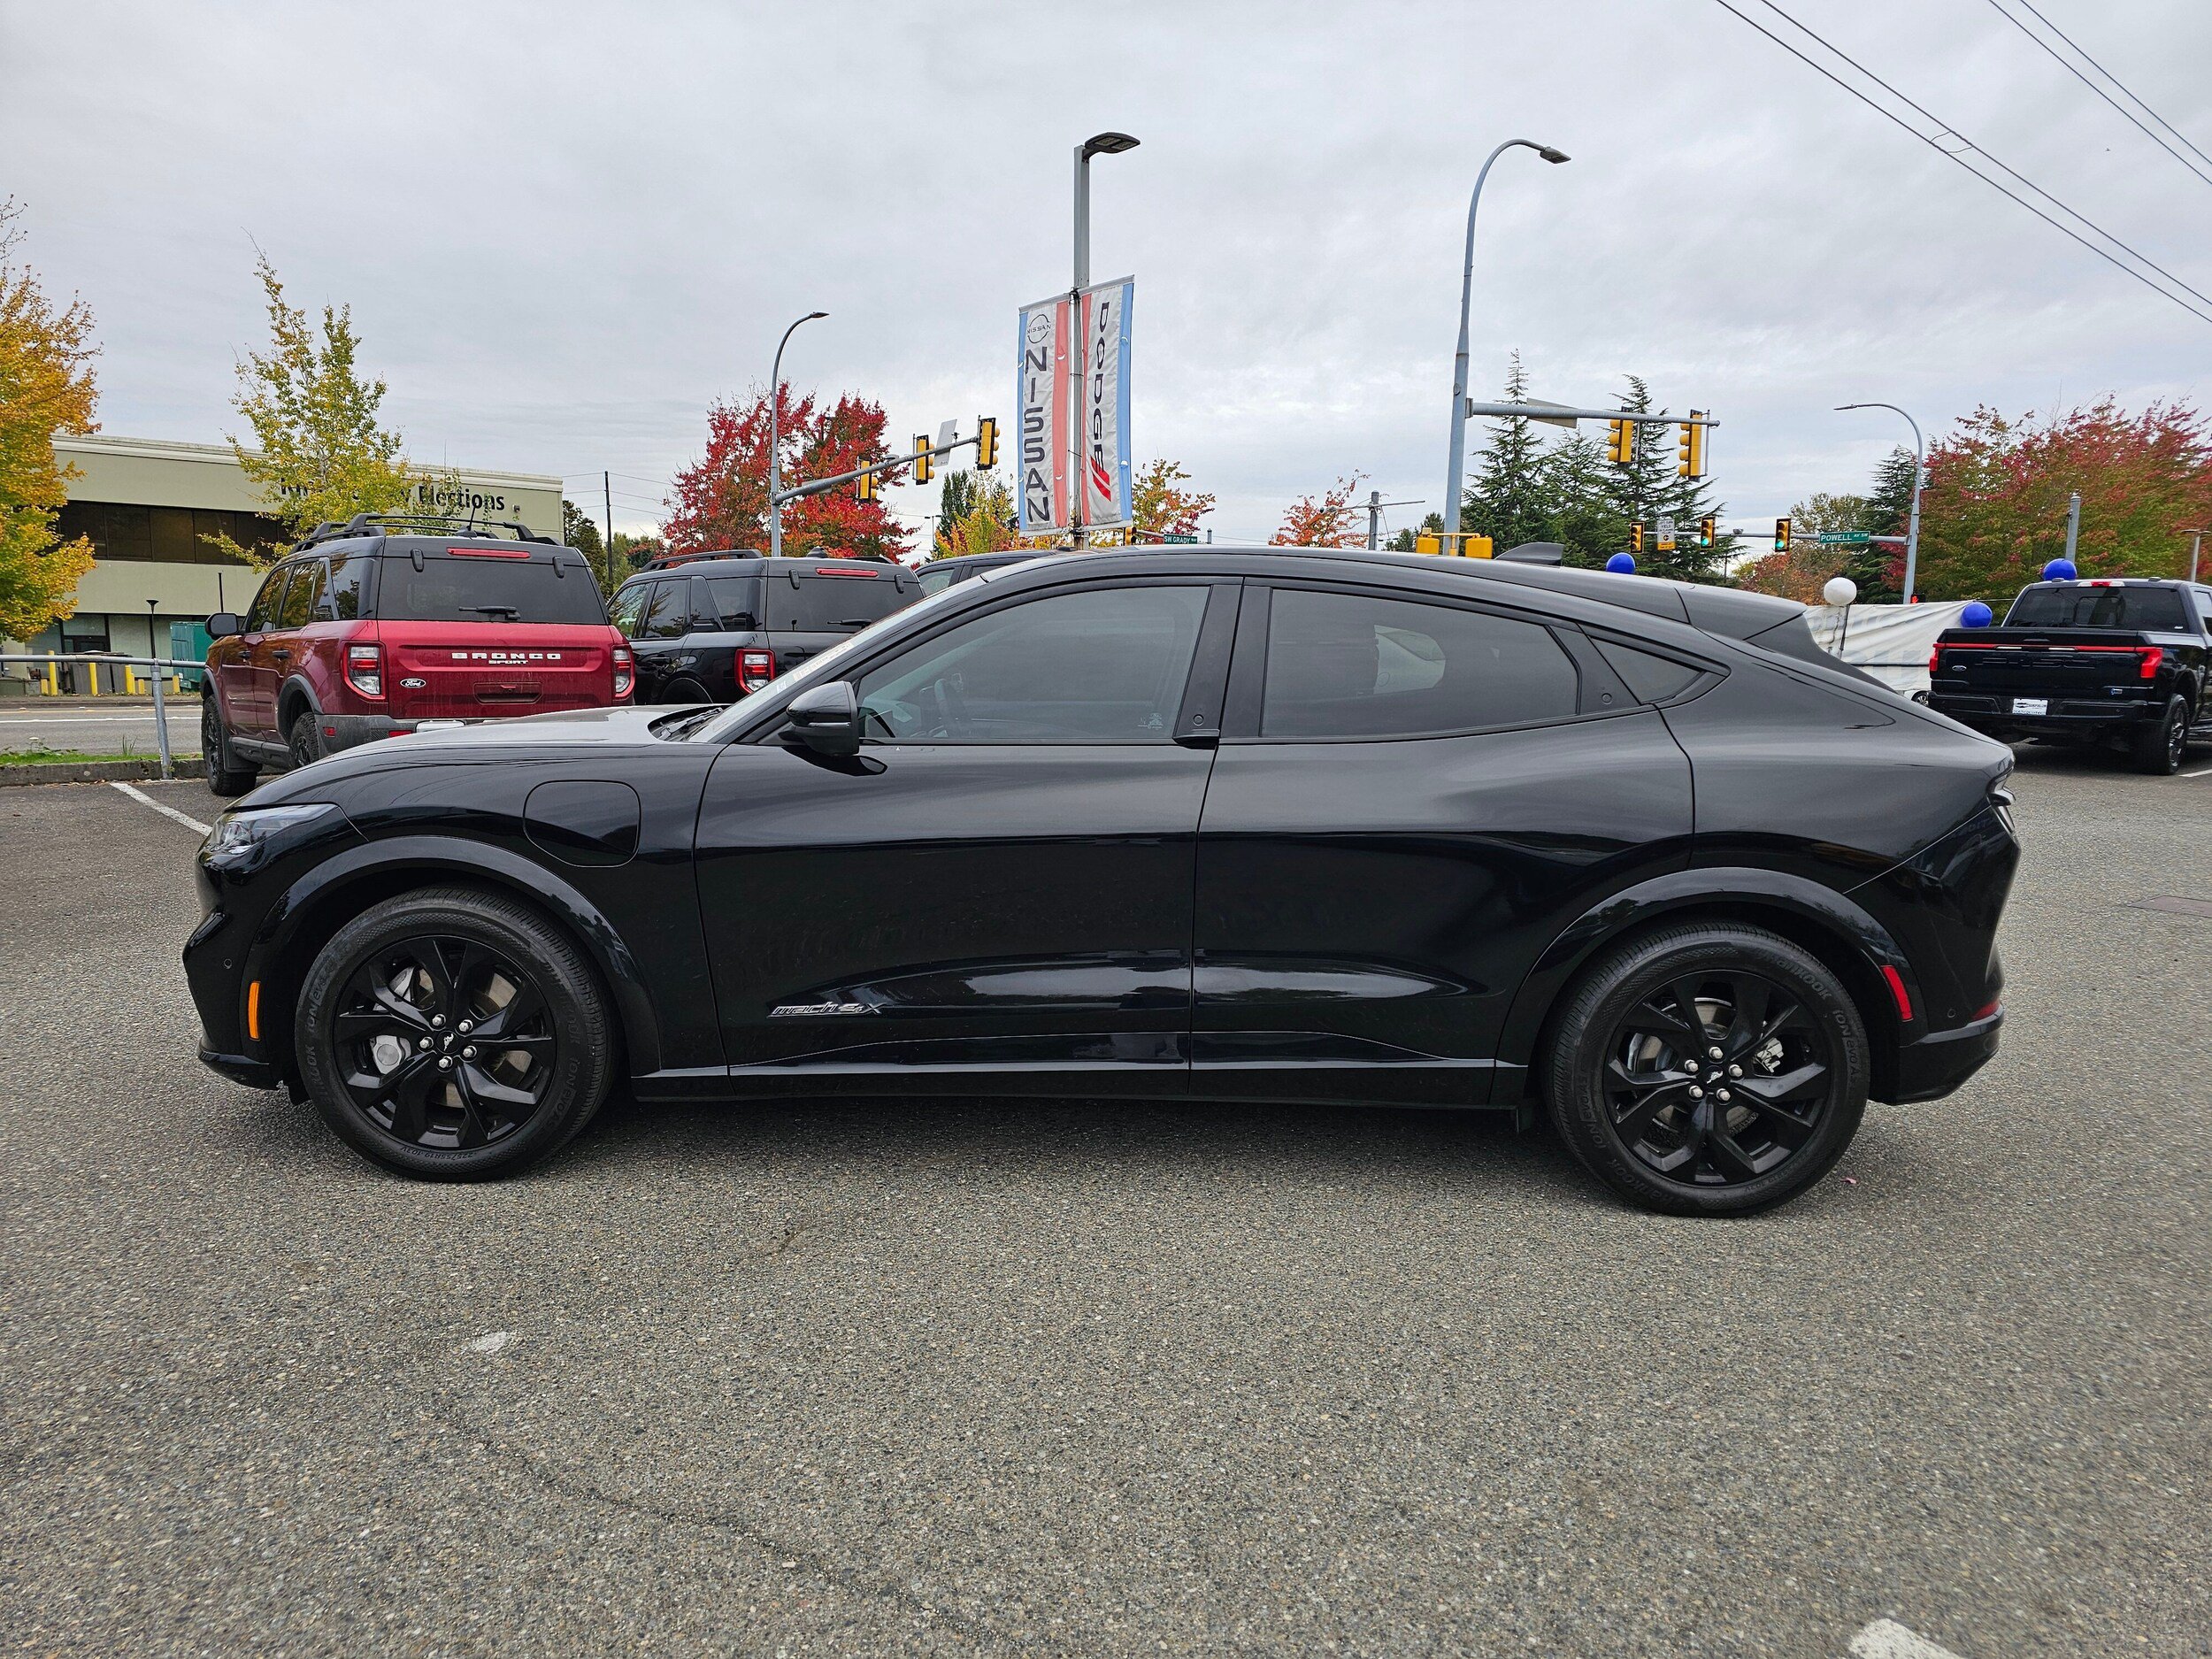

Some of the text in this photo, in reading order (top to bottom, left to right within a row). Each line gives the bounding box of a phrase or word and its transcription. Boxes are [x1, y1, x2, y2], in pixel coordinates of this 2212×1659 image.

[1026, 324, 1051, 334] NISSAN
[1094, 301, 1110, 475] DODGE
[1024, 346, 1050, 523] NISSAN
[418, 487, 505, 511] Elections
[403, 679, 423, 687] Ford
